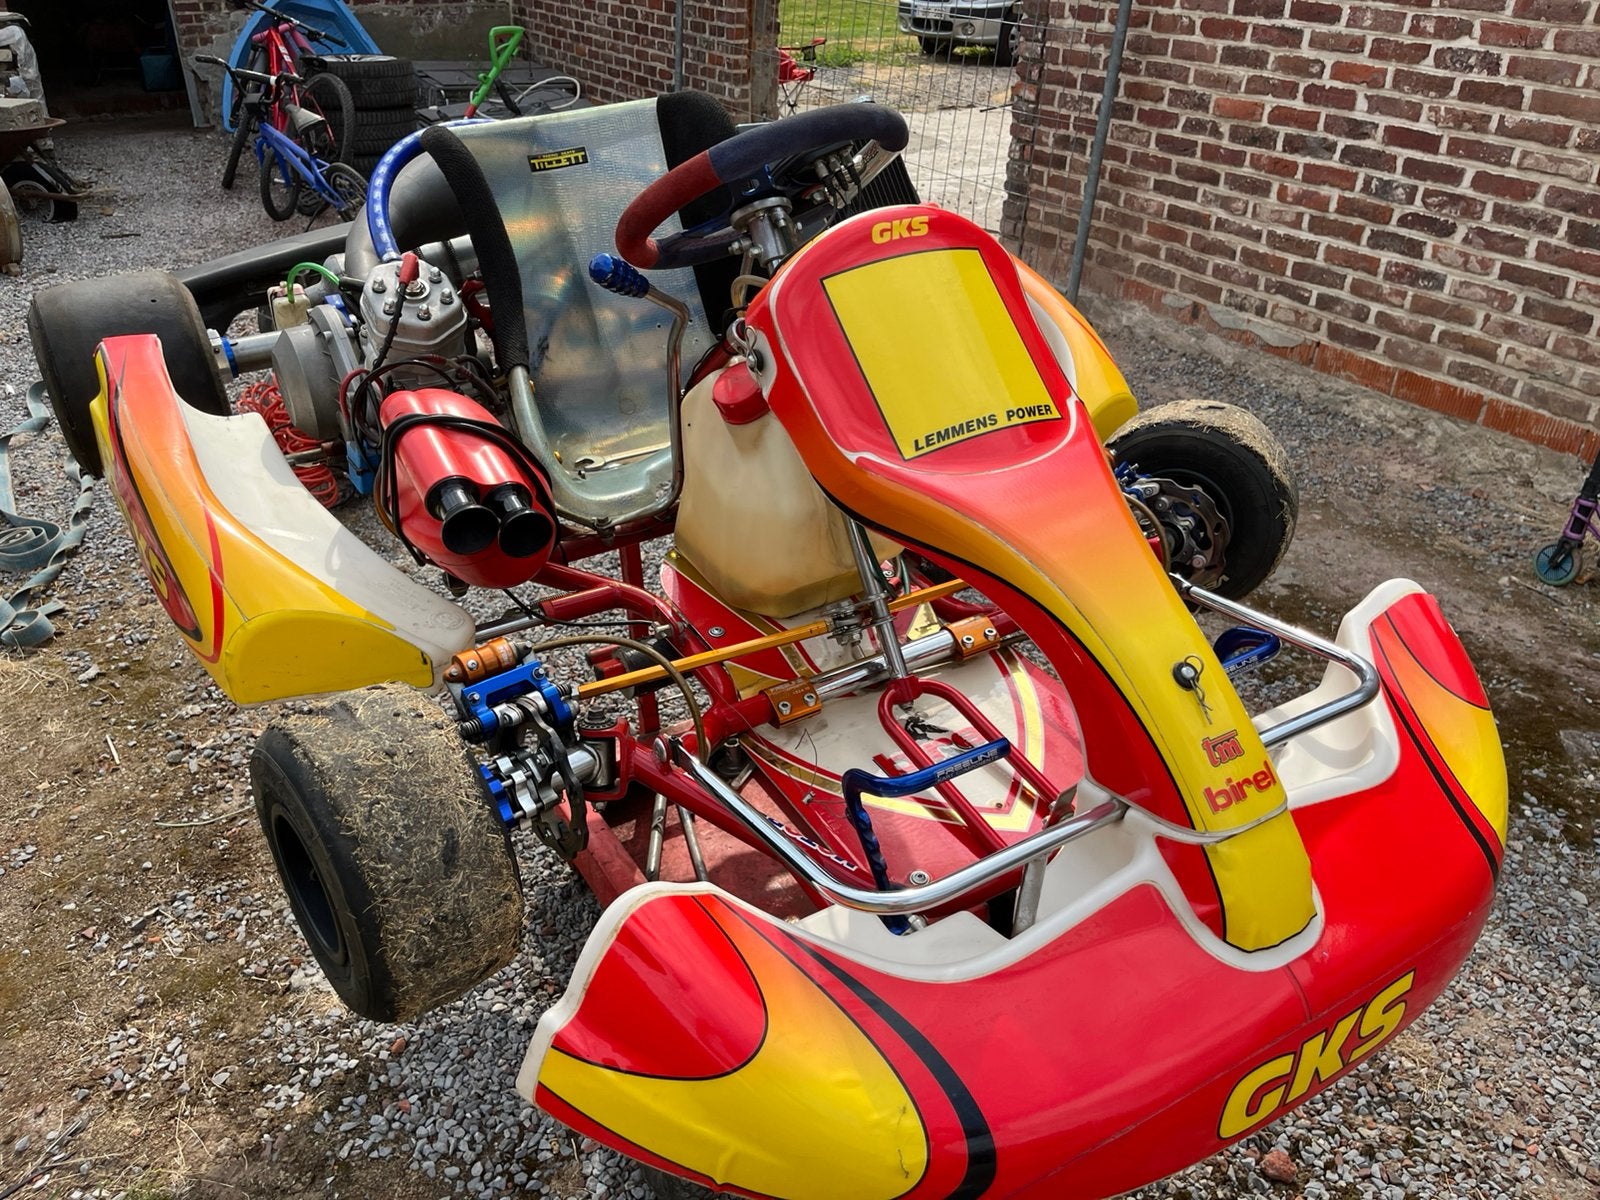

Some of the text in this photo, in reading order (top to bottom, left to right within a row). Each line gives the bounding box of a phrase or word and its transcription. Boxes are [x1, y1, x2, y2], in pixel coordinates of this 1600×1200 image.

[530, 151, 586, 170] TILLETT
[871, 215, 929, 245] GKS
[913, 404, 1053, 452] LEMMENS POWER
[936, 748, 998, 778] FREELINE
[1202, 728, 1245, 767] tm
[1203, 760, 1277, 815] birel
[1217, 967, 1416, 1140] GKS
